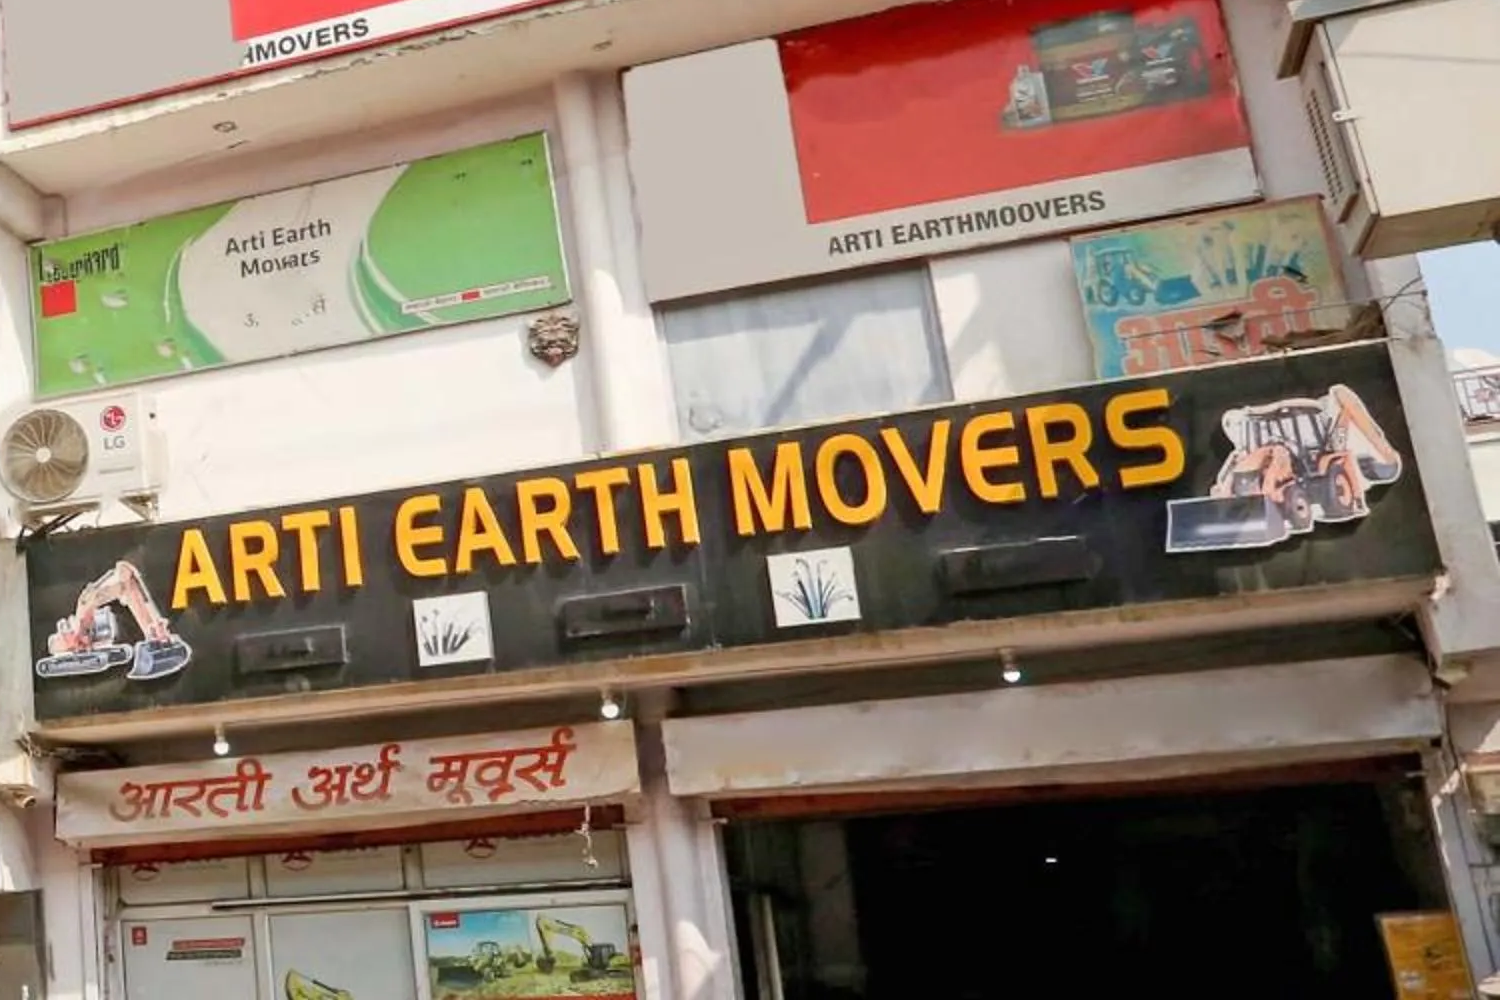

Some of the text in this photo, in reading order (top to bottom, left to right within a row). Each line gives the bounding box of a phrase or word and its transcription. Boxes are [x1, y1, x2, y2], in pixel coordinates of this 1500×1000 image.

[225, 218, 331, 256] Arti Earth
[828, 190, 1106, 257] ARTI EARTHMOOVERS
[103, 435, 126, 450] LG
[171, 387, 1188, 611] ARTI EARTH MOVERS
[109, 755, 271, 823] आरती
[292, 743, 402, 810] अर्थ
